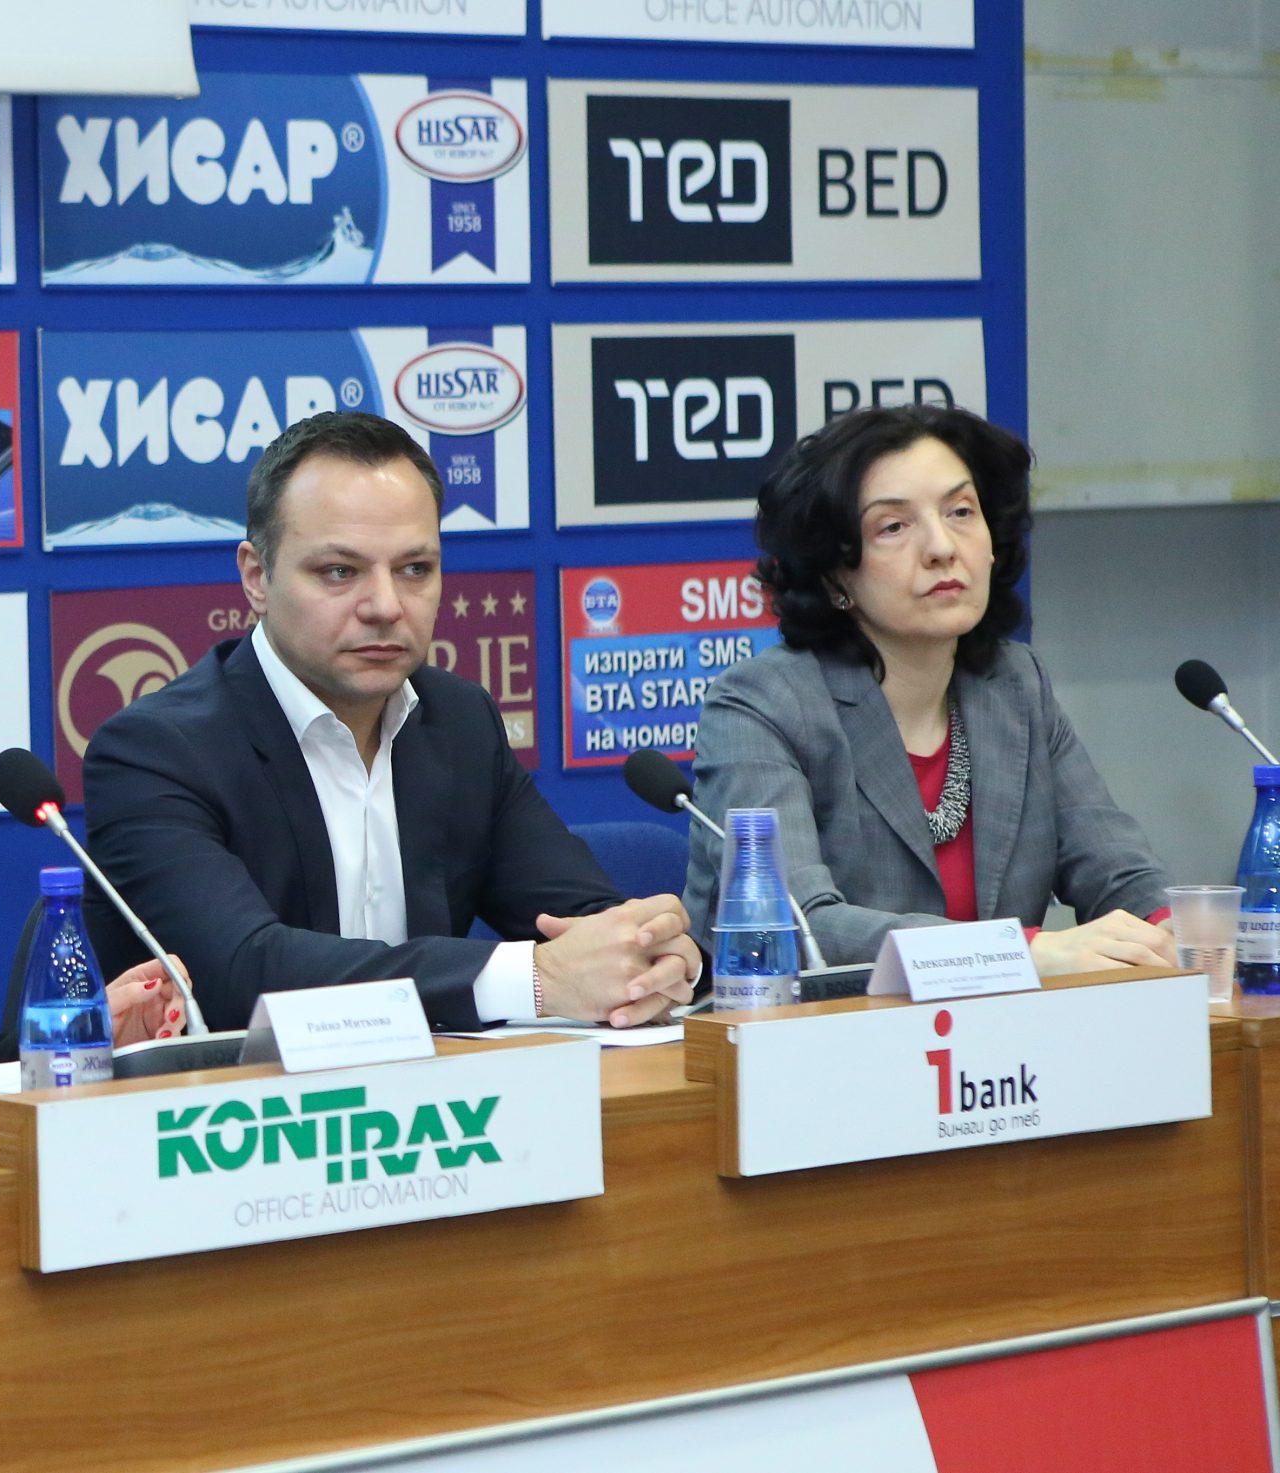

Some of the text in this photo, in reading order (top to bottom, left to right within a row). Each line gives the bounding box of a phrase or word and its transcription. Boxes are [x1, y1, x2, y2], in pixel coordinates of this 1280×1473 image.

[746, 0, 923, 31] AUTOMATION
[418, 115, 499, 146] HISSAR
[819, 148, 948, 219] BED
[447, 215, 482, 233] 1958
[417, 368, 499, 399] HISSAR
[447, 467, 482, 485] 1958
[680, 576, 764, 622] SMS
[208, 609, 258, 631] GRA
[584, 637, 752, 678] изпрати SMS
[585, 677, 717, 713] BTA STAR
[586, 722, 698, 751] на номер
[1251, 921, 1280, 931] wate
[157, 1086, 502, 1184] KONTRAX
[938, 1121, 985, 1139] Винаги
[989, 1117, 1007, 1137] до
[234, 1173, 469, 1228] OFFICE AUTOMATION
